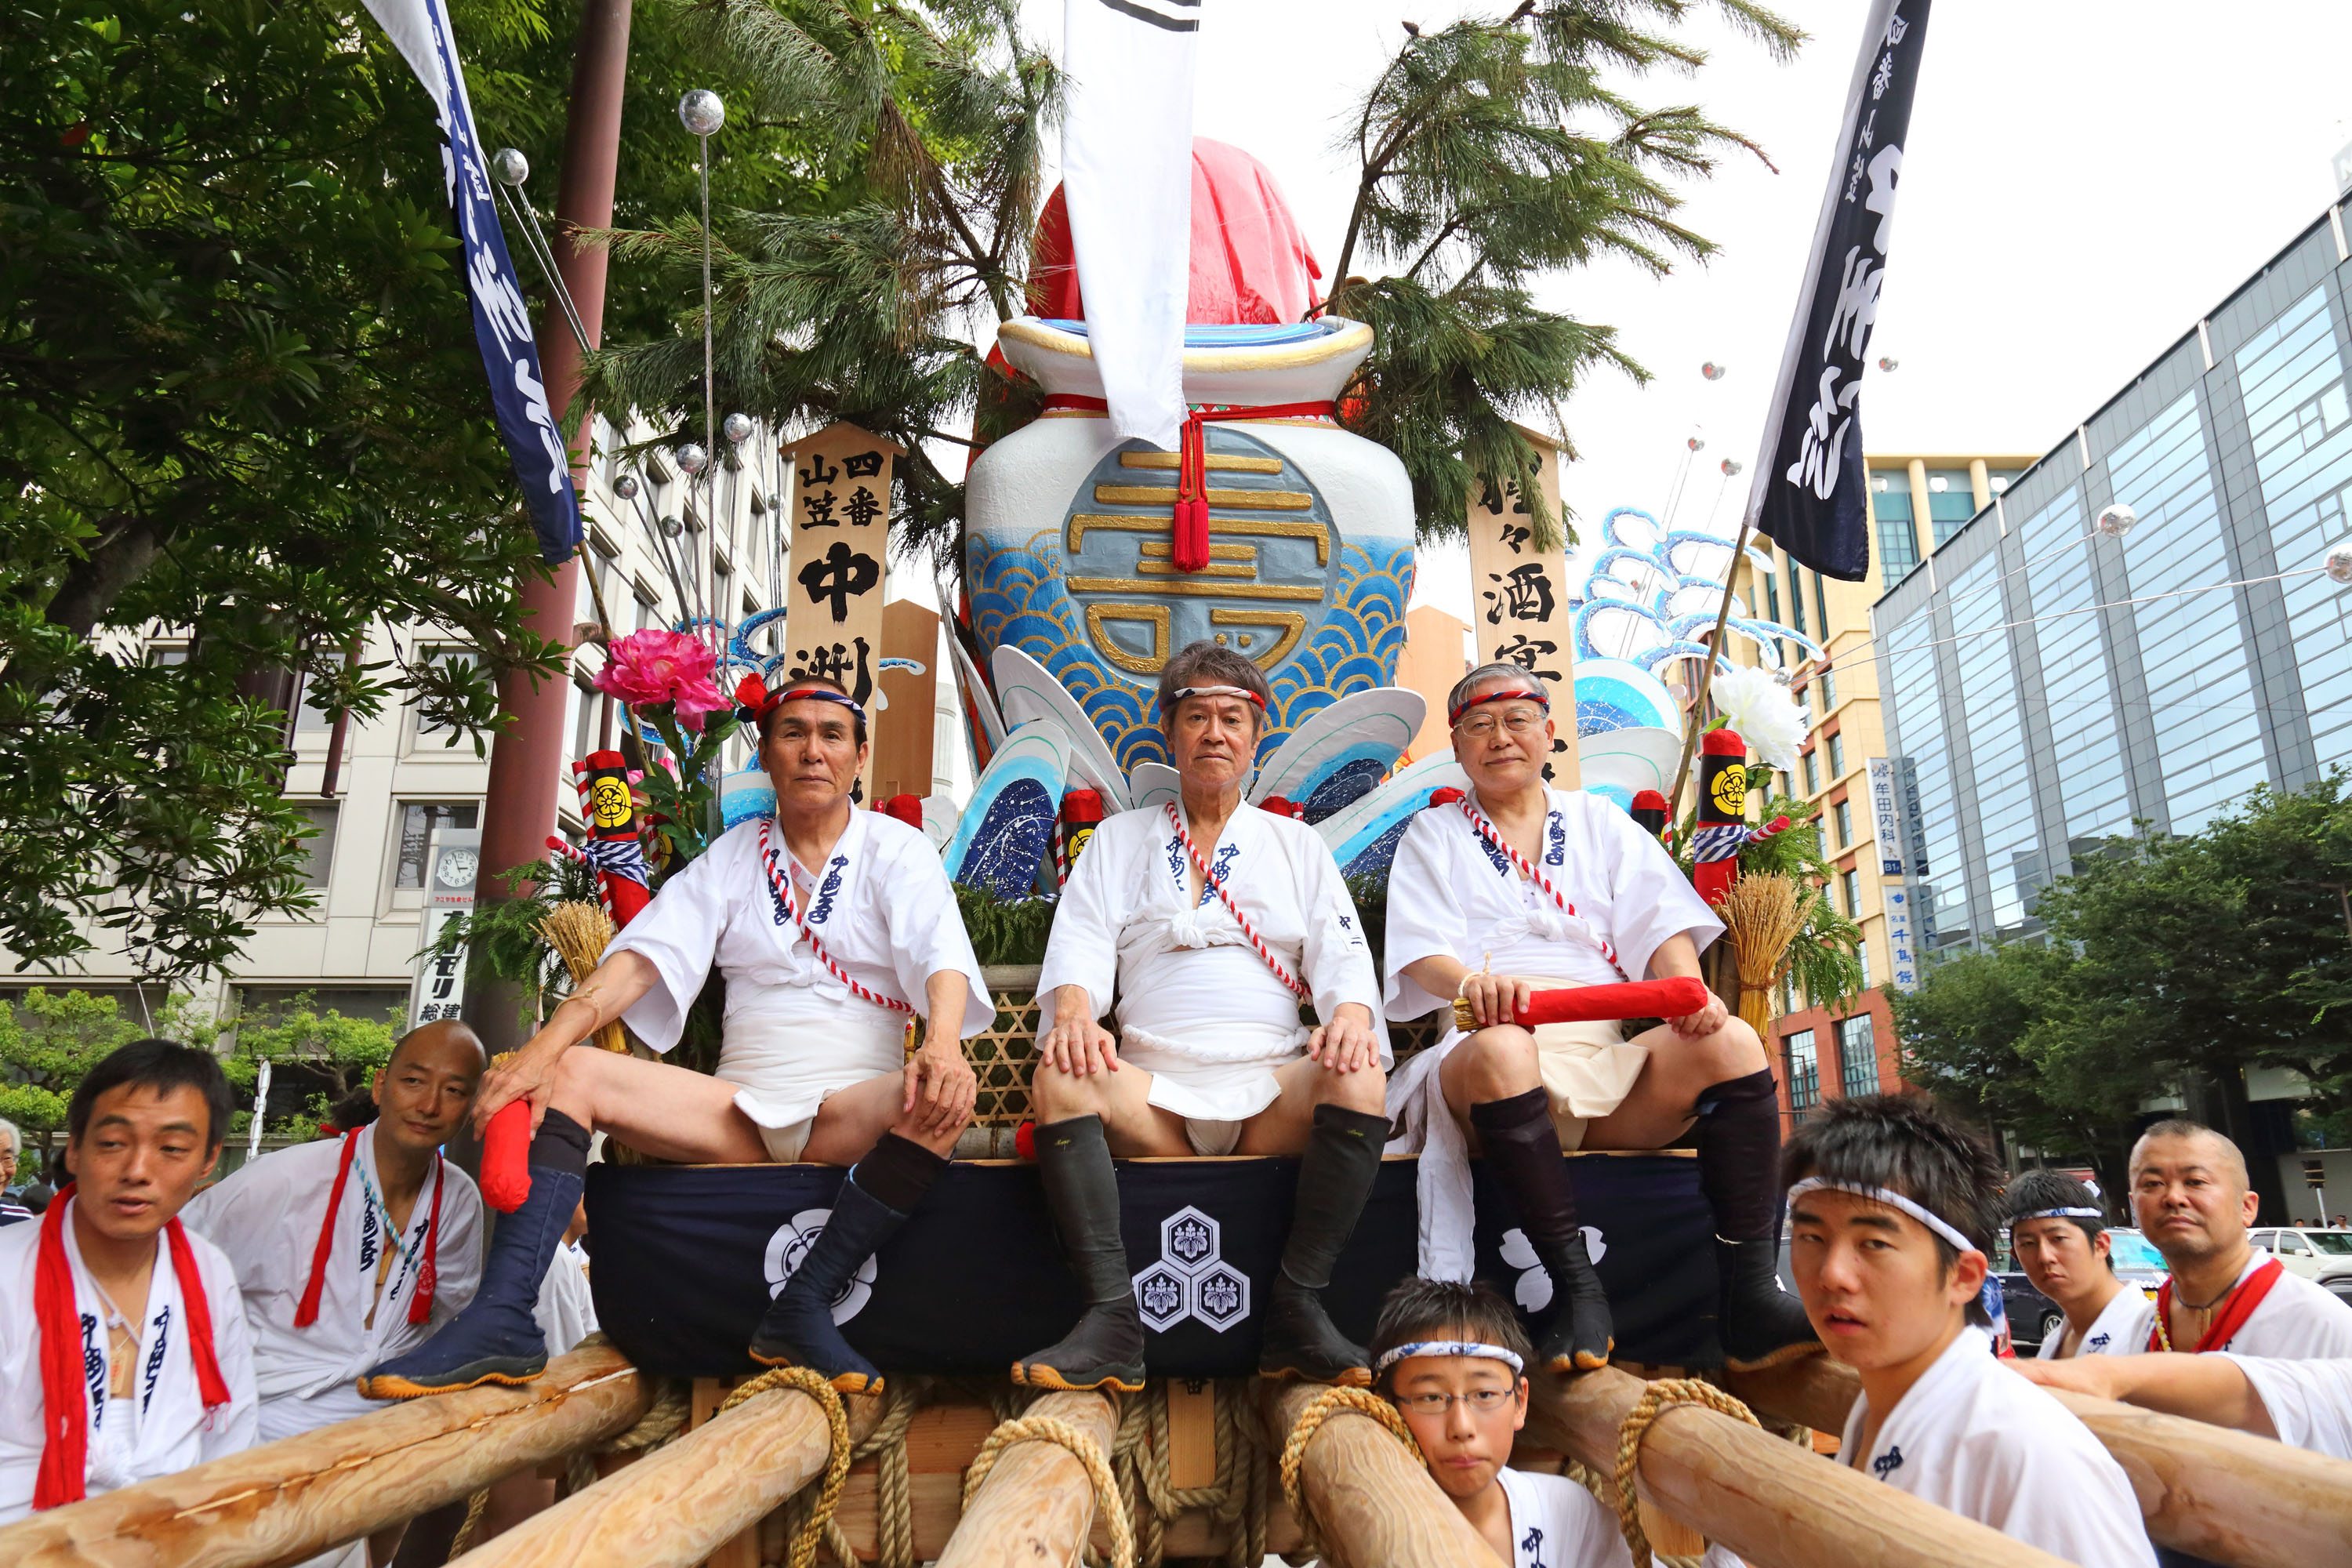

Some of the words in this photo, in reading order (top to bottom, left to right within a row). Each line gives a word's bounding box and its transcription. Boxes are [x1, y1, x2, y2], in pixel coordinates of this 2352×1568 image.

[798, 453, 840, 530] 山笠
[840, 451, 884, 527] 四番
[1875, 782, 1895, 843] 牟田内科
